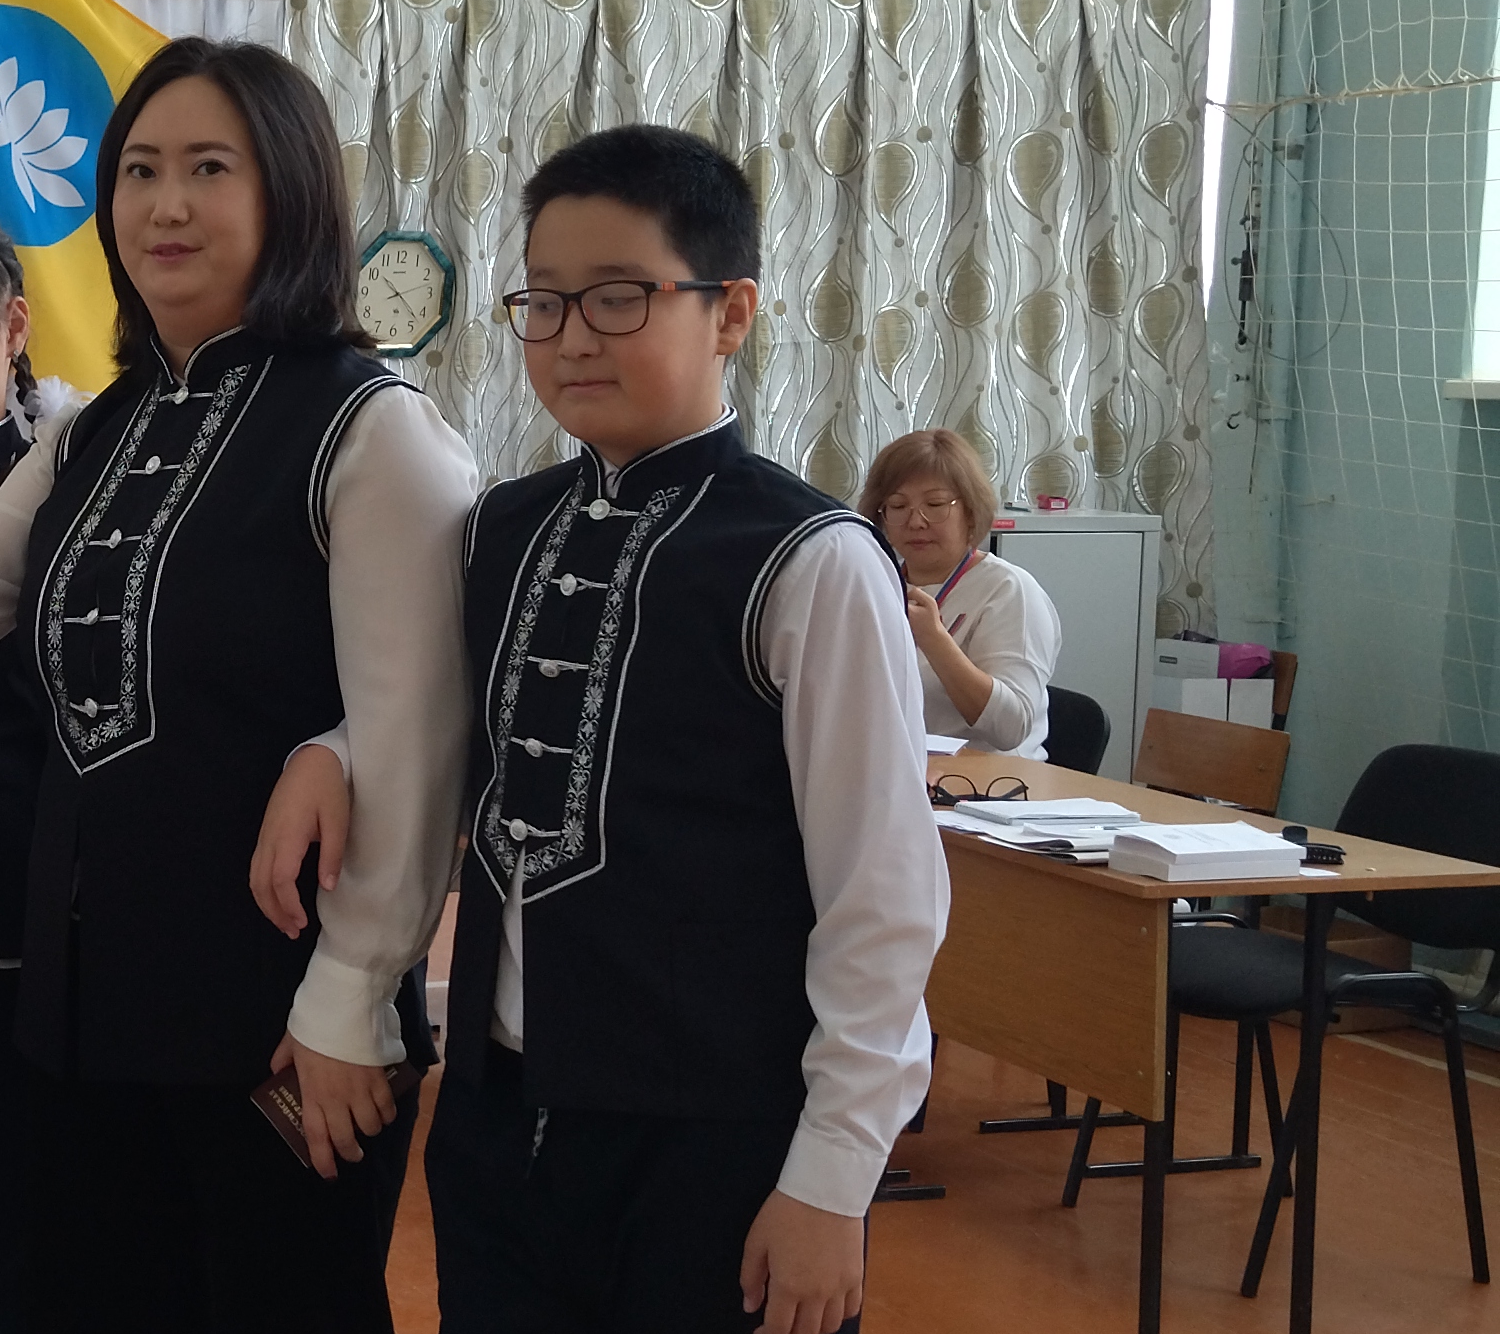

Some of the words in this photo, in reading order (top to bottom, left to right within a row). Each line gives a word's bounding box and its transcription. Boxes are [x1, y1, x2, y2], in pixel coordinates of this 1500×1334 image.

[381, 253, 390, 267] 11
[396, 250, 408, 264] 12
[415, 254, 420, 267] 1
[368, 267, 380, 281] 10
[422, 267, 431, 281] 2
[361, 285, 369, 299] 9
[426, 286, 433, 299] 3
[362, 305, 371, 319] 8
[419, 305, 426, 318] 4
[374, 320, 382, 333] 7
[389, 324, 397, 337] 6
[407, 320, 414, 333] 5
